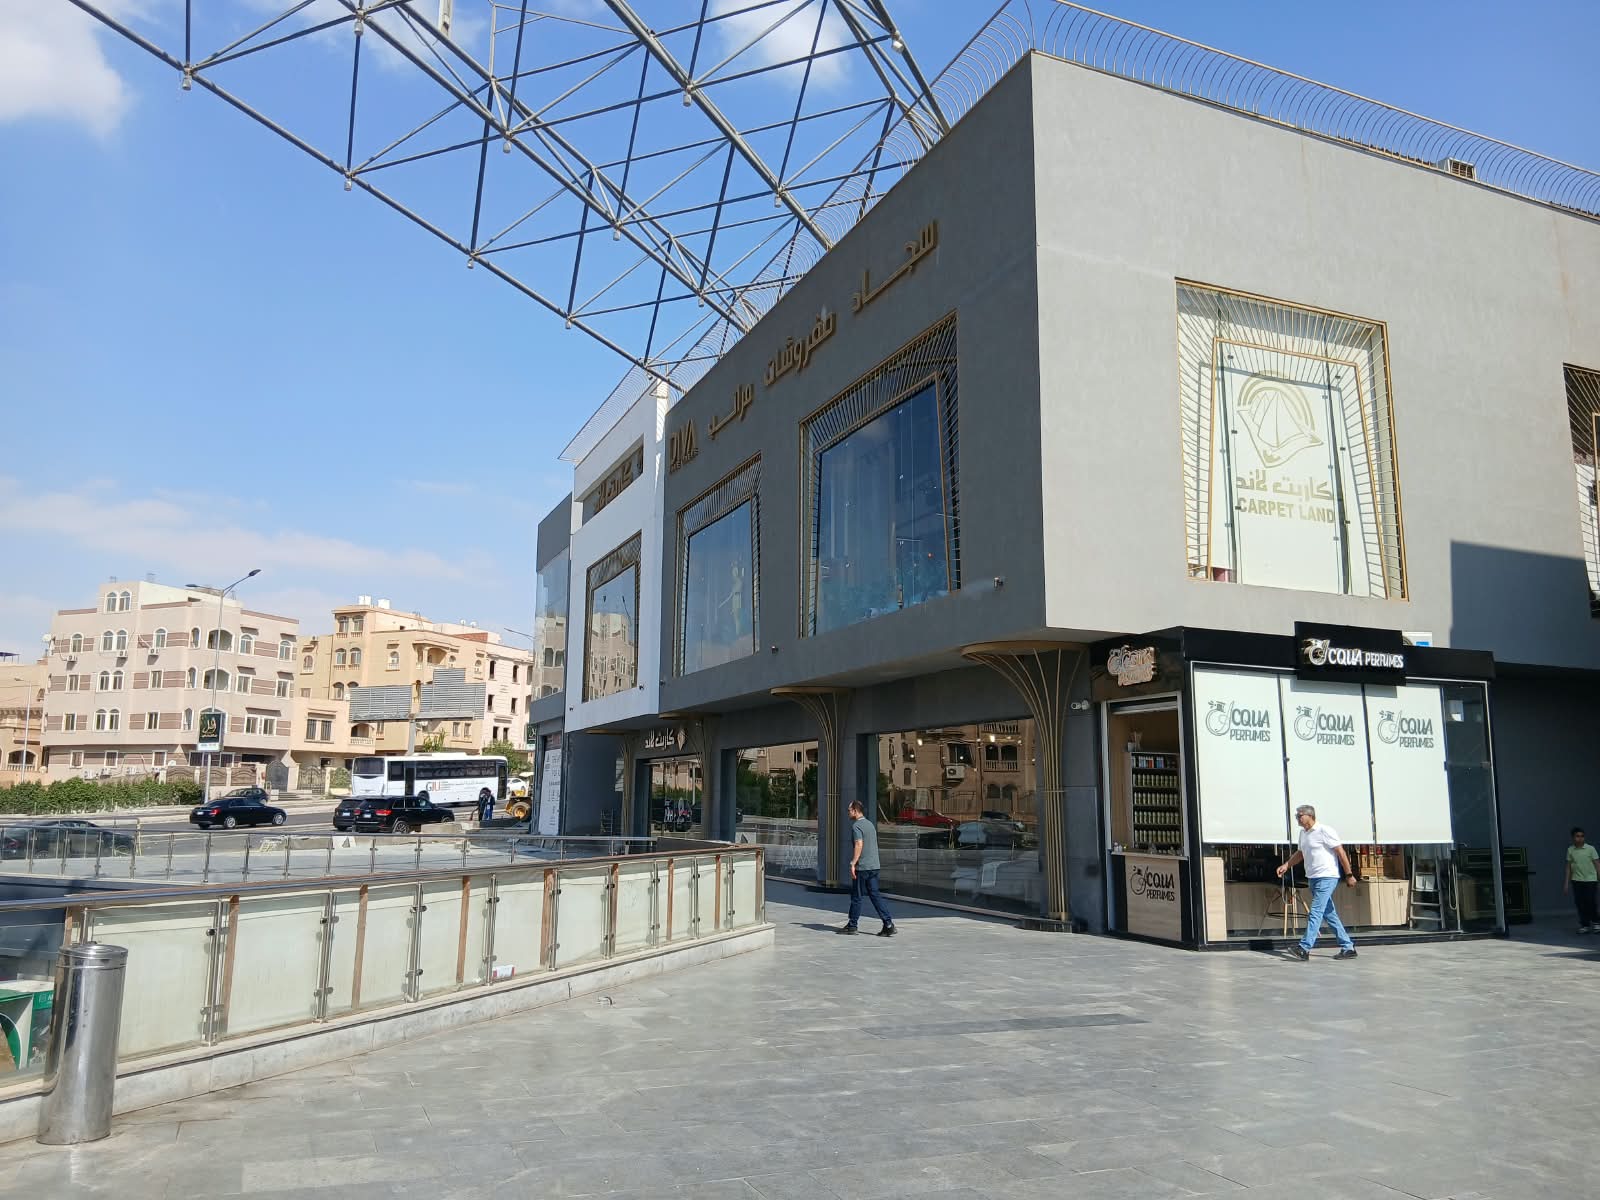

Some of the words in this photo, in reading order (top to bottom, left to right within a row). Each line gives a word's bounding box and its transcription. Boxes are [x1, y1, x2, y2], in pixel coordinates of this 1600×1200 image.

[848, 221, 936, 313] سجاد
[763, 311, 834, 386] مفروشات
[1235, 468, 1268, 492] لاند
[1272, 476, 1335, 502] كاربت
[1237, 497, 1294, 519] CARPET
[1298, 504, 1336, 524] LAND
[1364, 651, 1404, 669] PERFUMES
[1229, 728, 1271, 742] PERFUMES
[1316, 733, 1355, 746] PERFUMES
[1399, 736, 1435, 749] PERFUMES
[1146, 889, 1176, 902] PERFUMES
